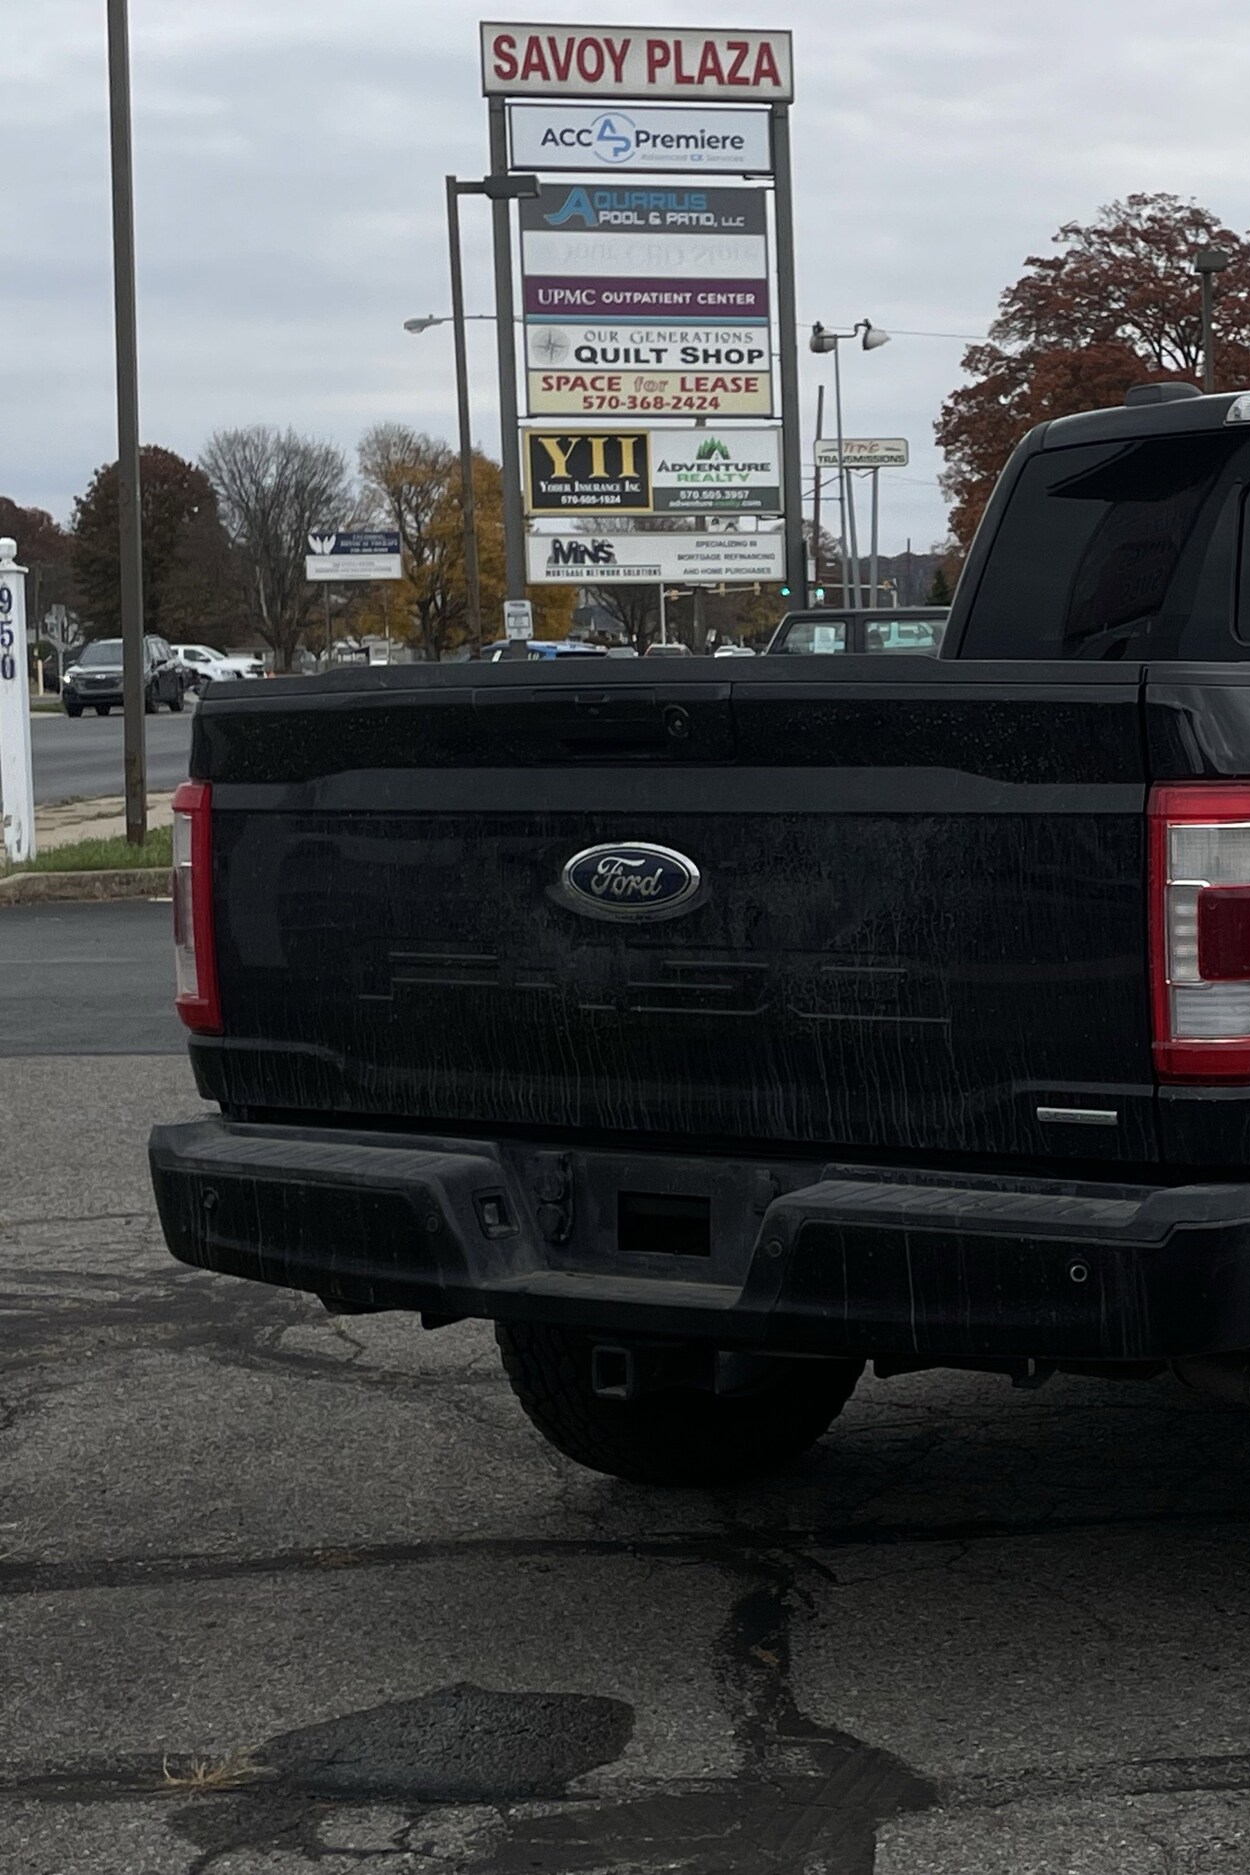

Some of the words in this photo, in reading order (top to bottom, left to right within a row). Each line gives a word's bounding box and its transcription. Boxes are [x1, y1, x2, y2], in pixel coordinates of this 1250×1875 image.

[492, 33, 631, 83] SAVOY
[646, 38, 782, 87] PLAZA
[540, 128, 593, 147] ACC
[635, 129, 744, 150] Premiere
[544, 187, 708, 227] AQUARIUS
[599, 210, 645, 225] POOL
[649, 212, 661, 225] &
[666, 212, 718, 227] PATIO,
[721, 215, 745, 227] LLC
[538, 288, 597, 306] UPMC
[602, 291, 692, 305] OUTPATIENT
[697, 293, 756, 305] CENTER
[584, 330, 620, 342] OUR
[629, 330, 754, 344] GENERATIONS
[574, 345, 668, 364] QUILT
[680, 346, 765, 364] SHOP
[541, 375, 622, 393] SPACE
[634, 375, 669, 393] for
[680, 376, 759, 393] LEASE
[582, 395, 720, 411] 570-368-2424
[538, 436, 641, 479] YII
[656, 459, 771, 473] ADVENTURE
[817, 454, 905, 464] TRASMISSIONS
[676, 473, 750, 482] REALTY
[551, 538, 615, 564] MNS
[677, 553, 721, 561] MORTGAGE
[545, 568, 584, 577] MORTGAGE
[586, 568, 620, 577] NETWORK
[622, 568, 662, 577] SOLUTIONS
[724, 567, 772, 575] PURCHASES
[0, 587, 15, 680] 950
[590, 856, 663, 897] Ford
